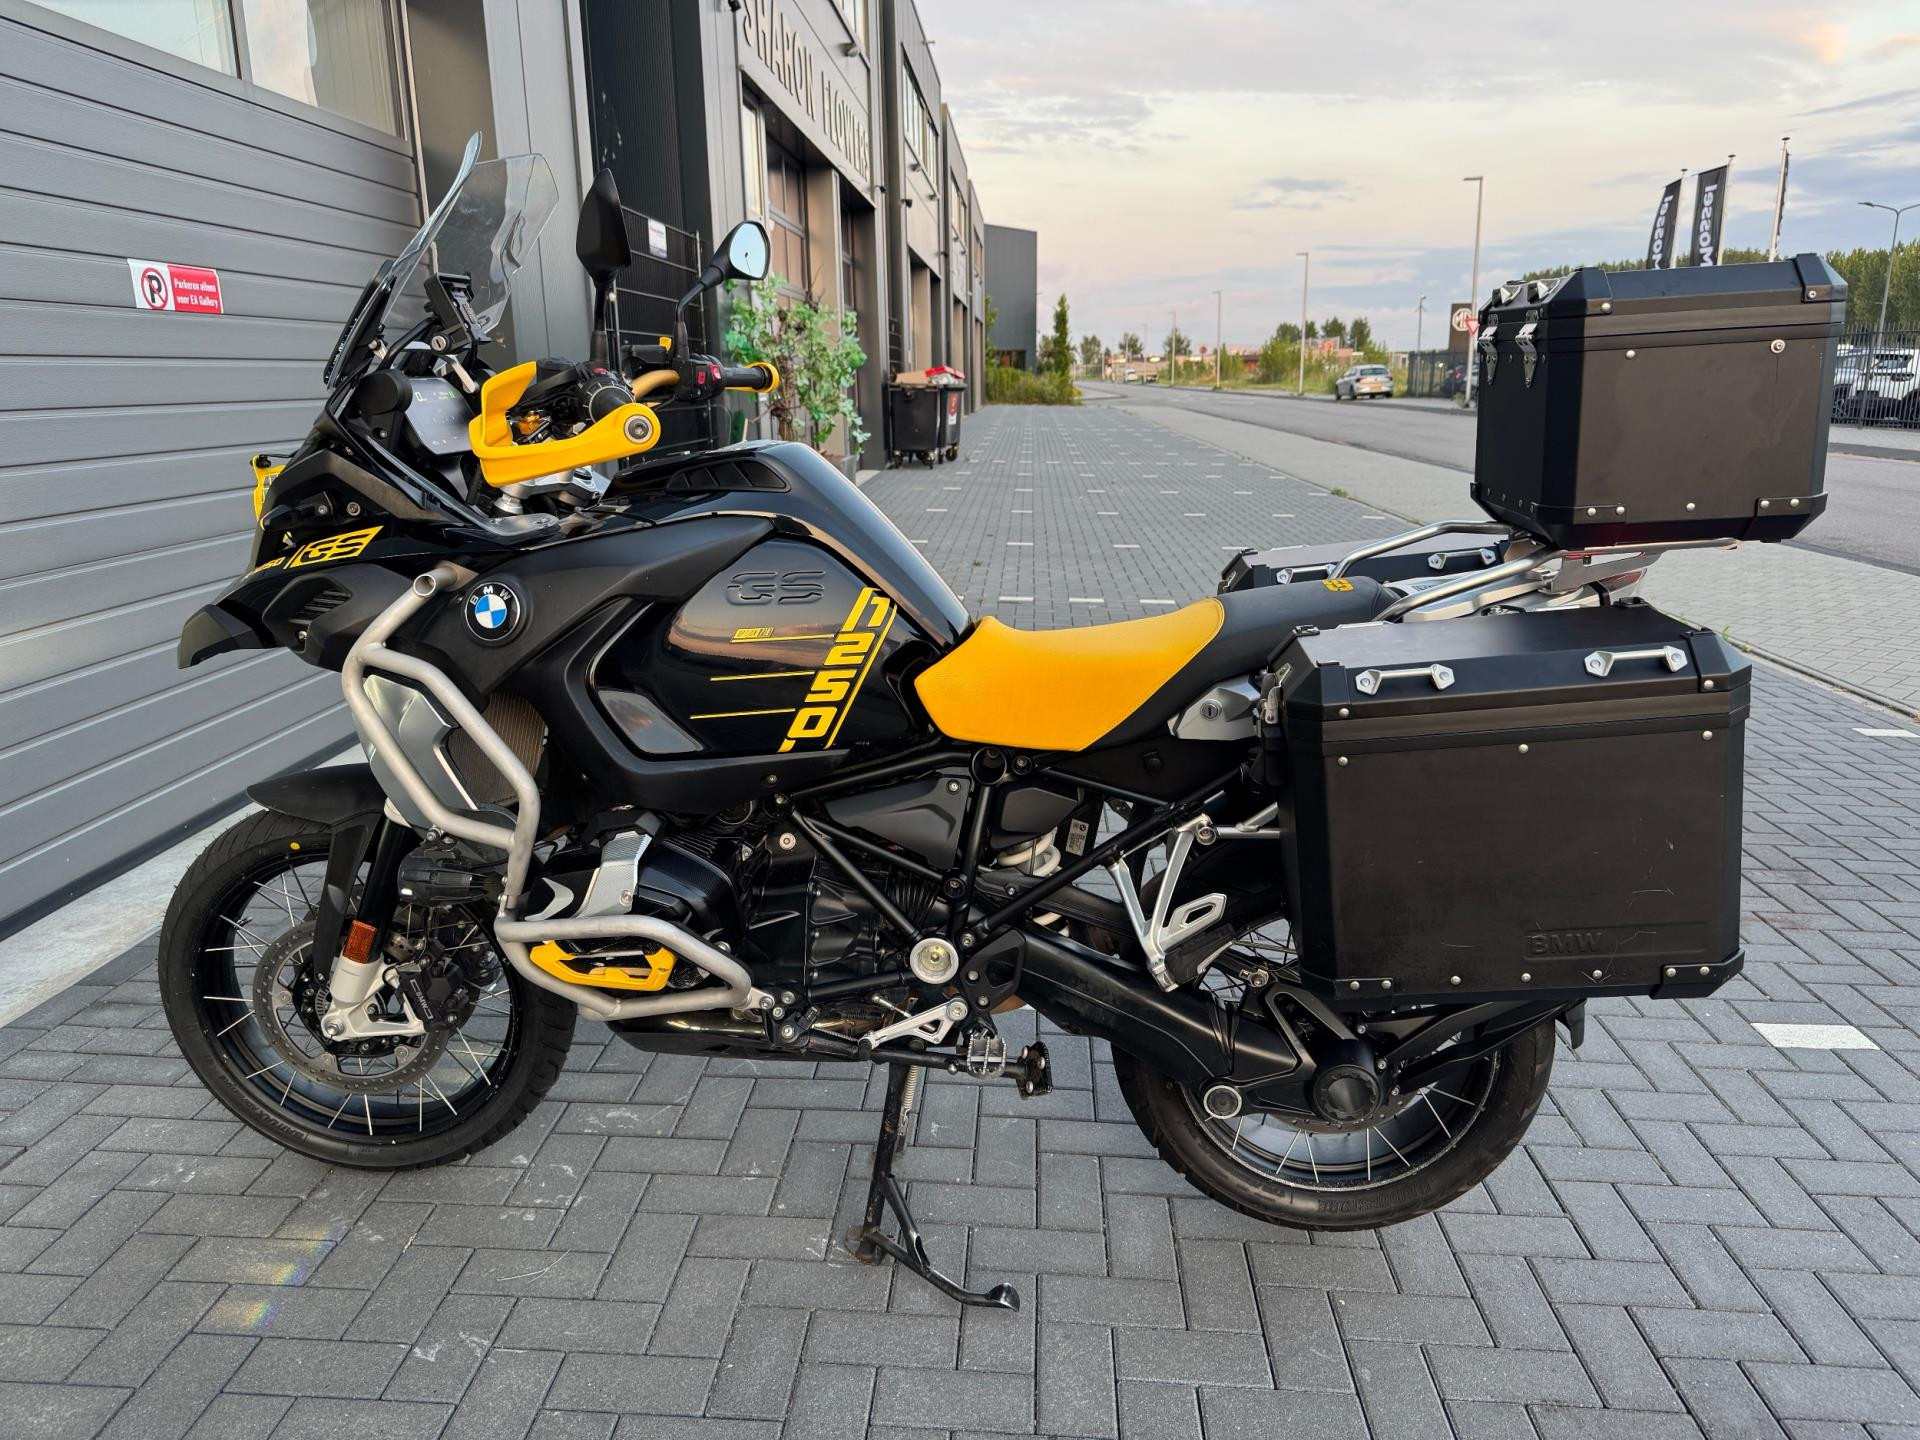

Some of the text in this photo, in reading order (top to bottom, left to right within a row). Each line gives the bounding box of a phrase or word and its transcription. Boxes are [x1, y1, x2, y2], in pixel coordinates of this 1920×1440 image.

[821, 70, 868, 182] FLOWERS
[174, 278, 216, 293] Parkeren alleen
[176, 295, 218, 308] voor EA Gallery
[299, 533, 371, 563] GS
[470, 585, 511, 605] BMW
[725, 571, 826, 606] GS
[1530, 932, 1602, 955] BMW
